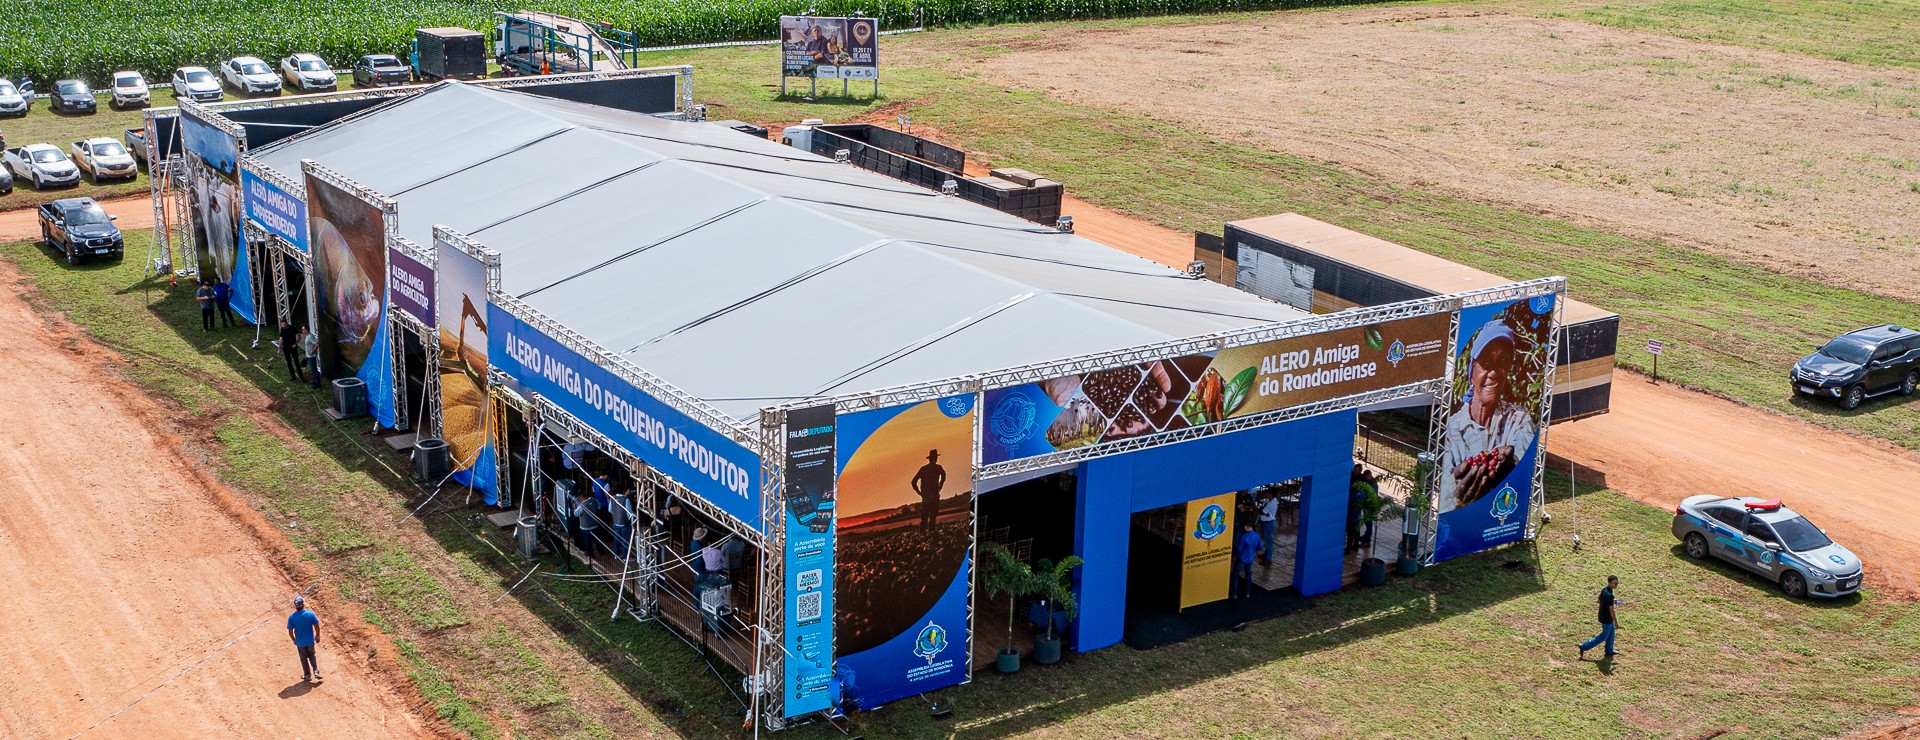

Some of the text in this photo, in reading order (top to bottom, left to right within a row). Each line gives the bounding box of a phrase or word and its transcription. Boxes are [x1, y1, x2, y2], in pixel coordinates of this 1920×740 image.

[251, 179, 296, 219] ALERO AMIGA DO
[252, 200, 297, 241] EMPREENDEDOR
[392, 265, 424, 293] ALERO AMIGA
[393, 278, 428, 310] DO AGRICULTOR
[1260, 344, 1359, 376] ALERO Amiga
[505, 332, 749, 500] ALERO AMIGA DO PEQUENO PRODUTOR
[790, 430, 801, 438] FALA
